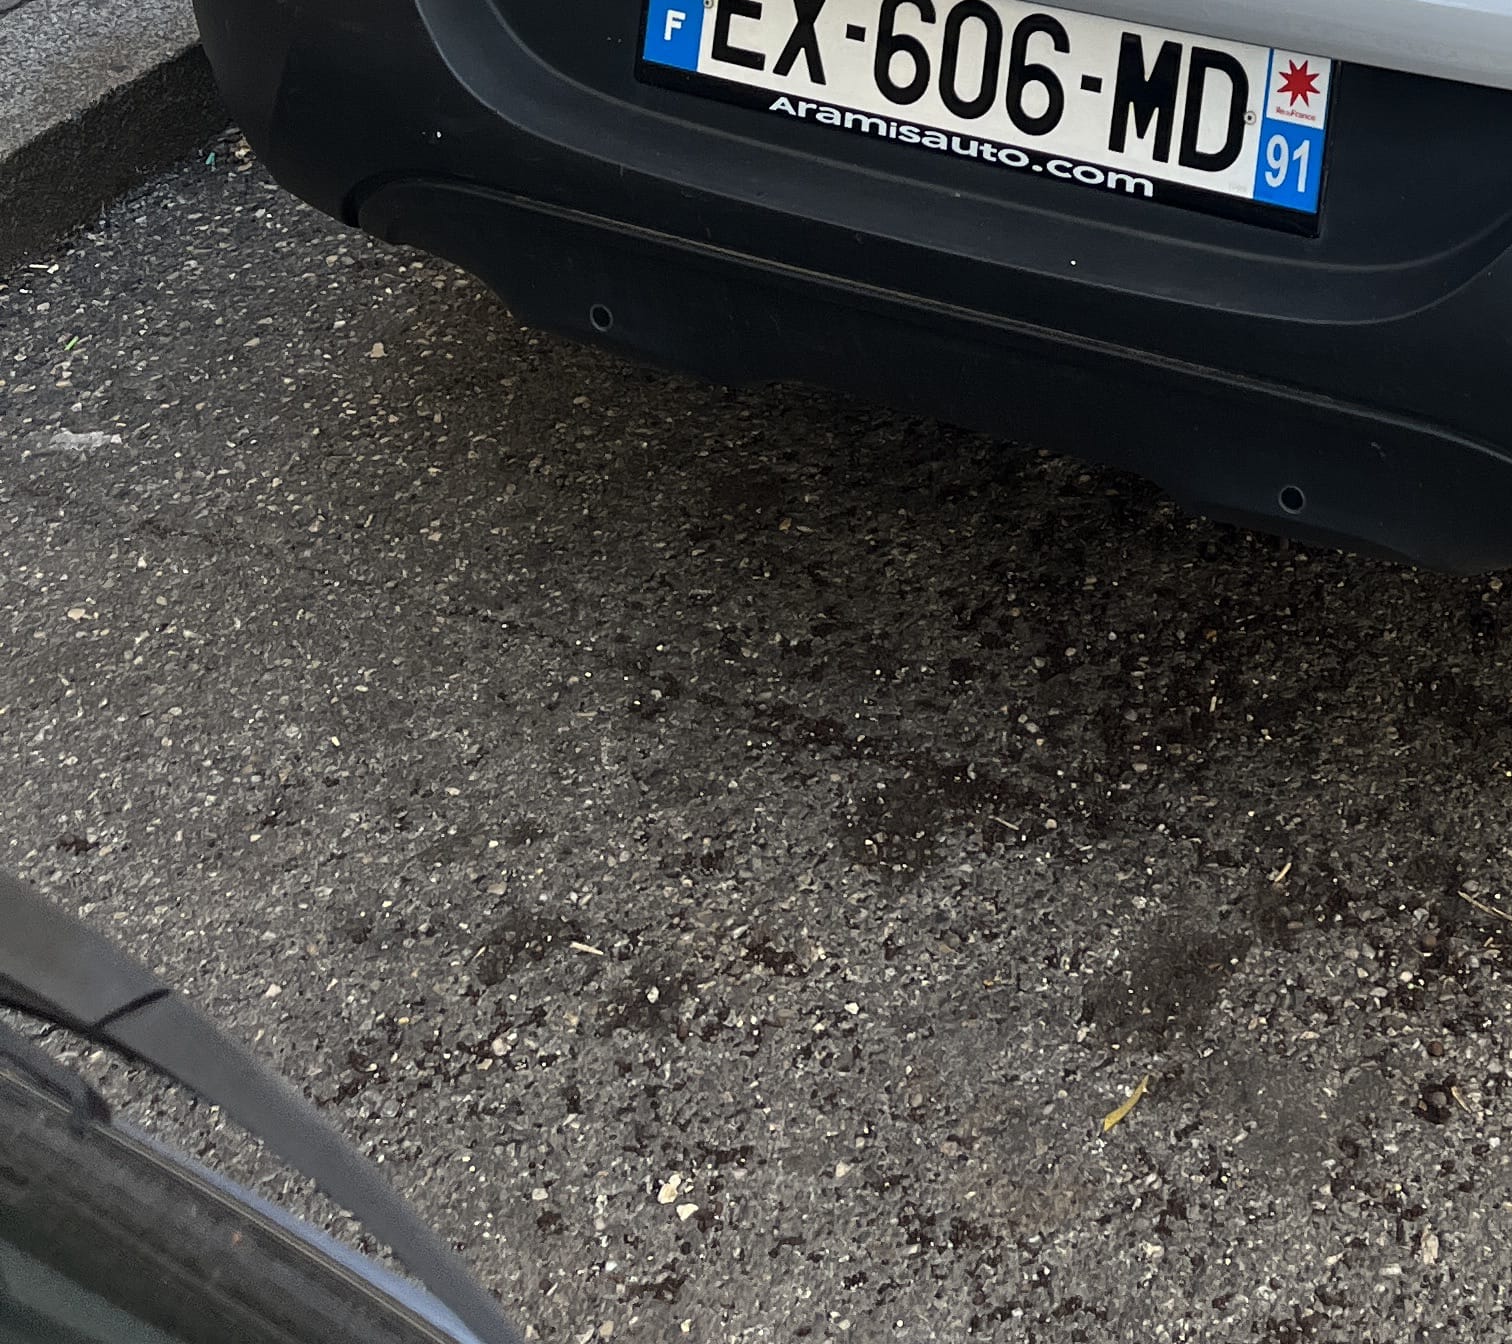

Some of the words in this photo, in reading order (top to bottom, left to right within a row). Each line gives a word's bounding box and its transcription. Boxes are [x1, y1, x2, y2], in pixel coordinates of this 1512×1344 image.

[663, 9, 687, 42] F
[768, 96, 1155, 198] Aramisauto.com
[1264, 133, 1311, 193] 91
